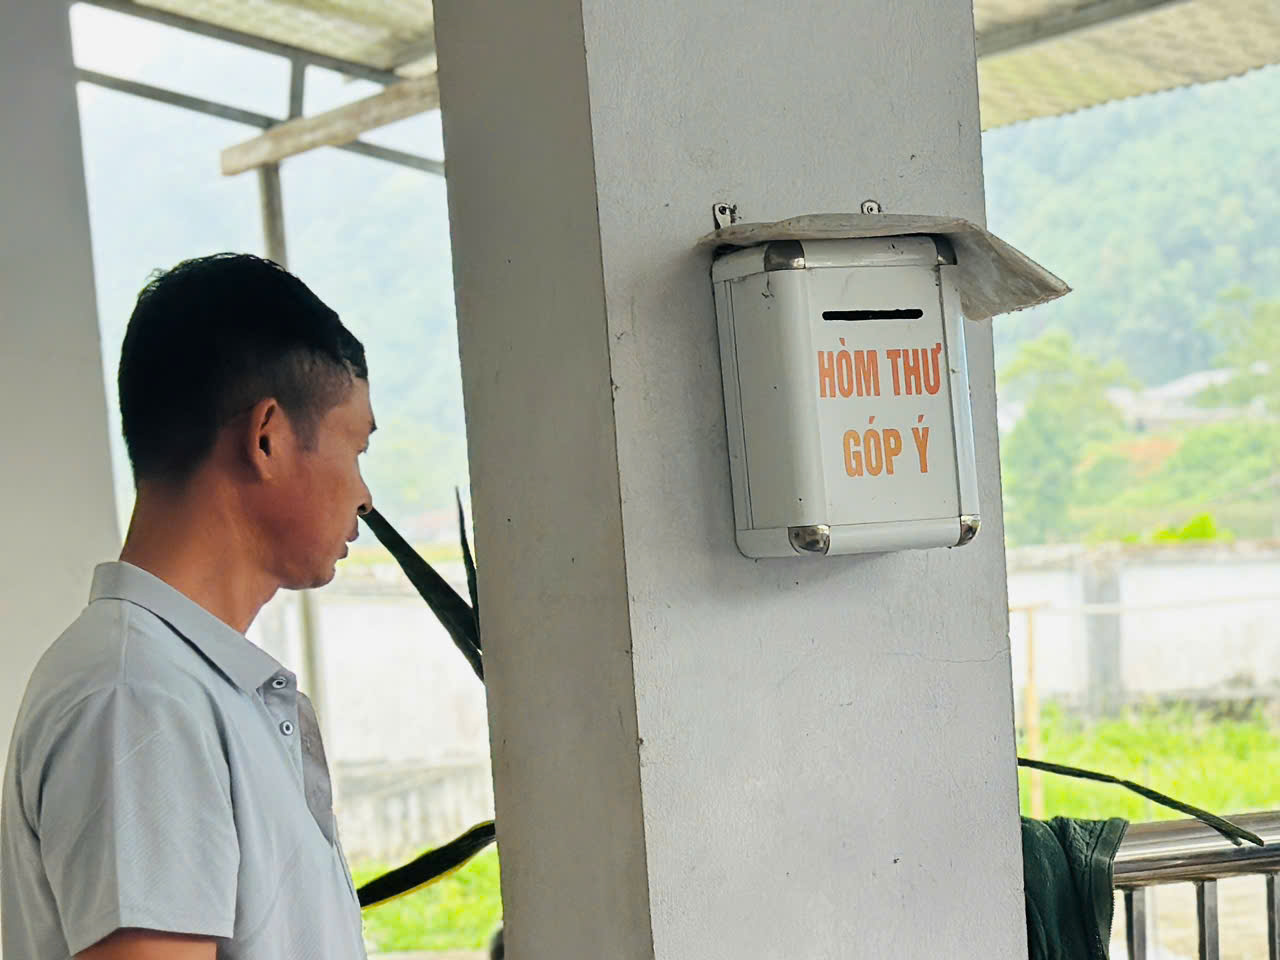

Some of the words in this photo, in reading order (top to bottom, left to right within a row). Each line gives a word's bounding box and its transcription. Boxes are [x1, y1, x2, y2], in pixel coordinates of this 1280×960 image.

[818, 337, 880, 397] HÒM
[887, 342, 941, 396] THƯ
[843, 415, 902, 477] GÓP
[911, 414, 930, 473] Ý
